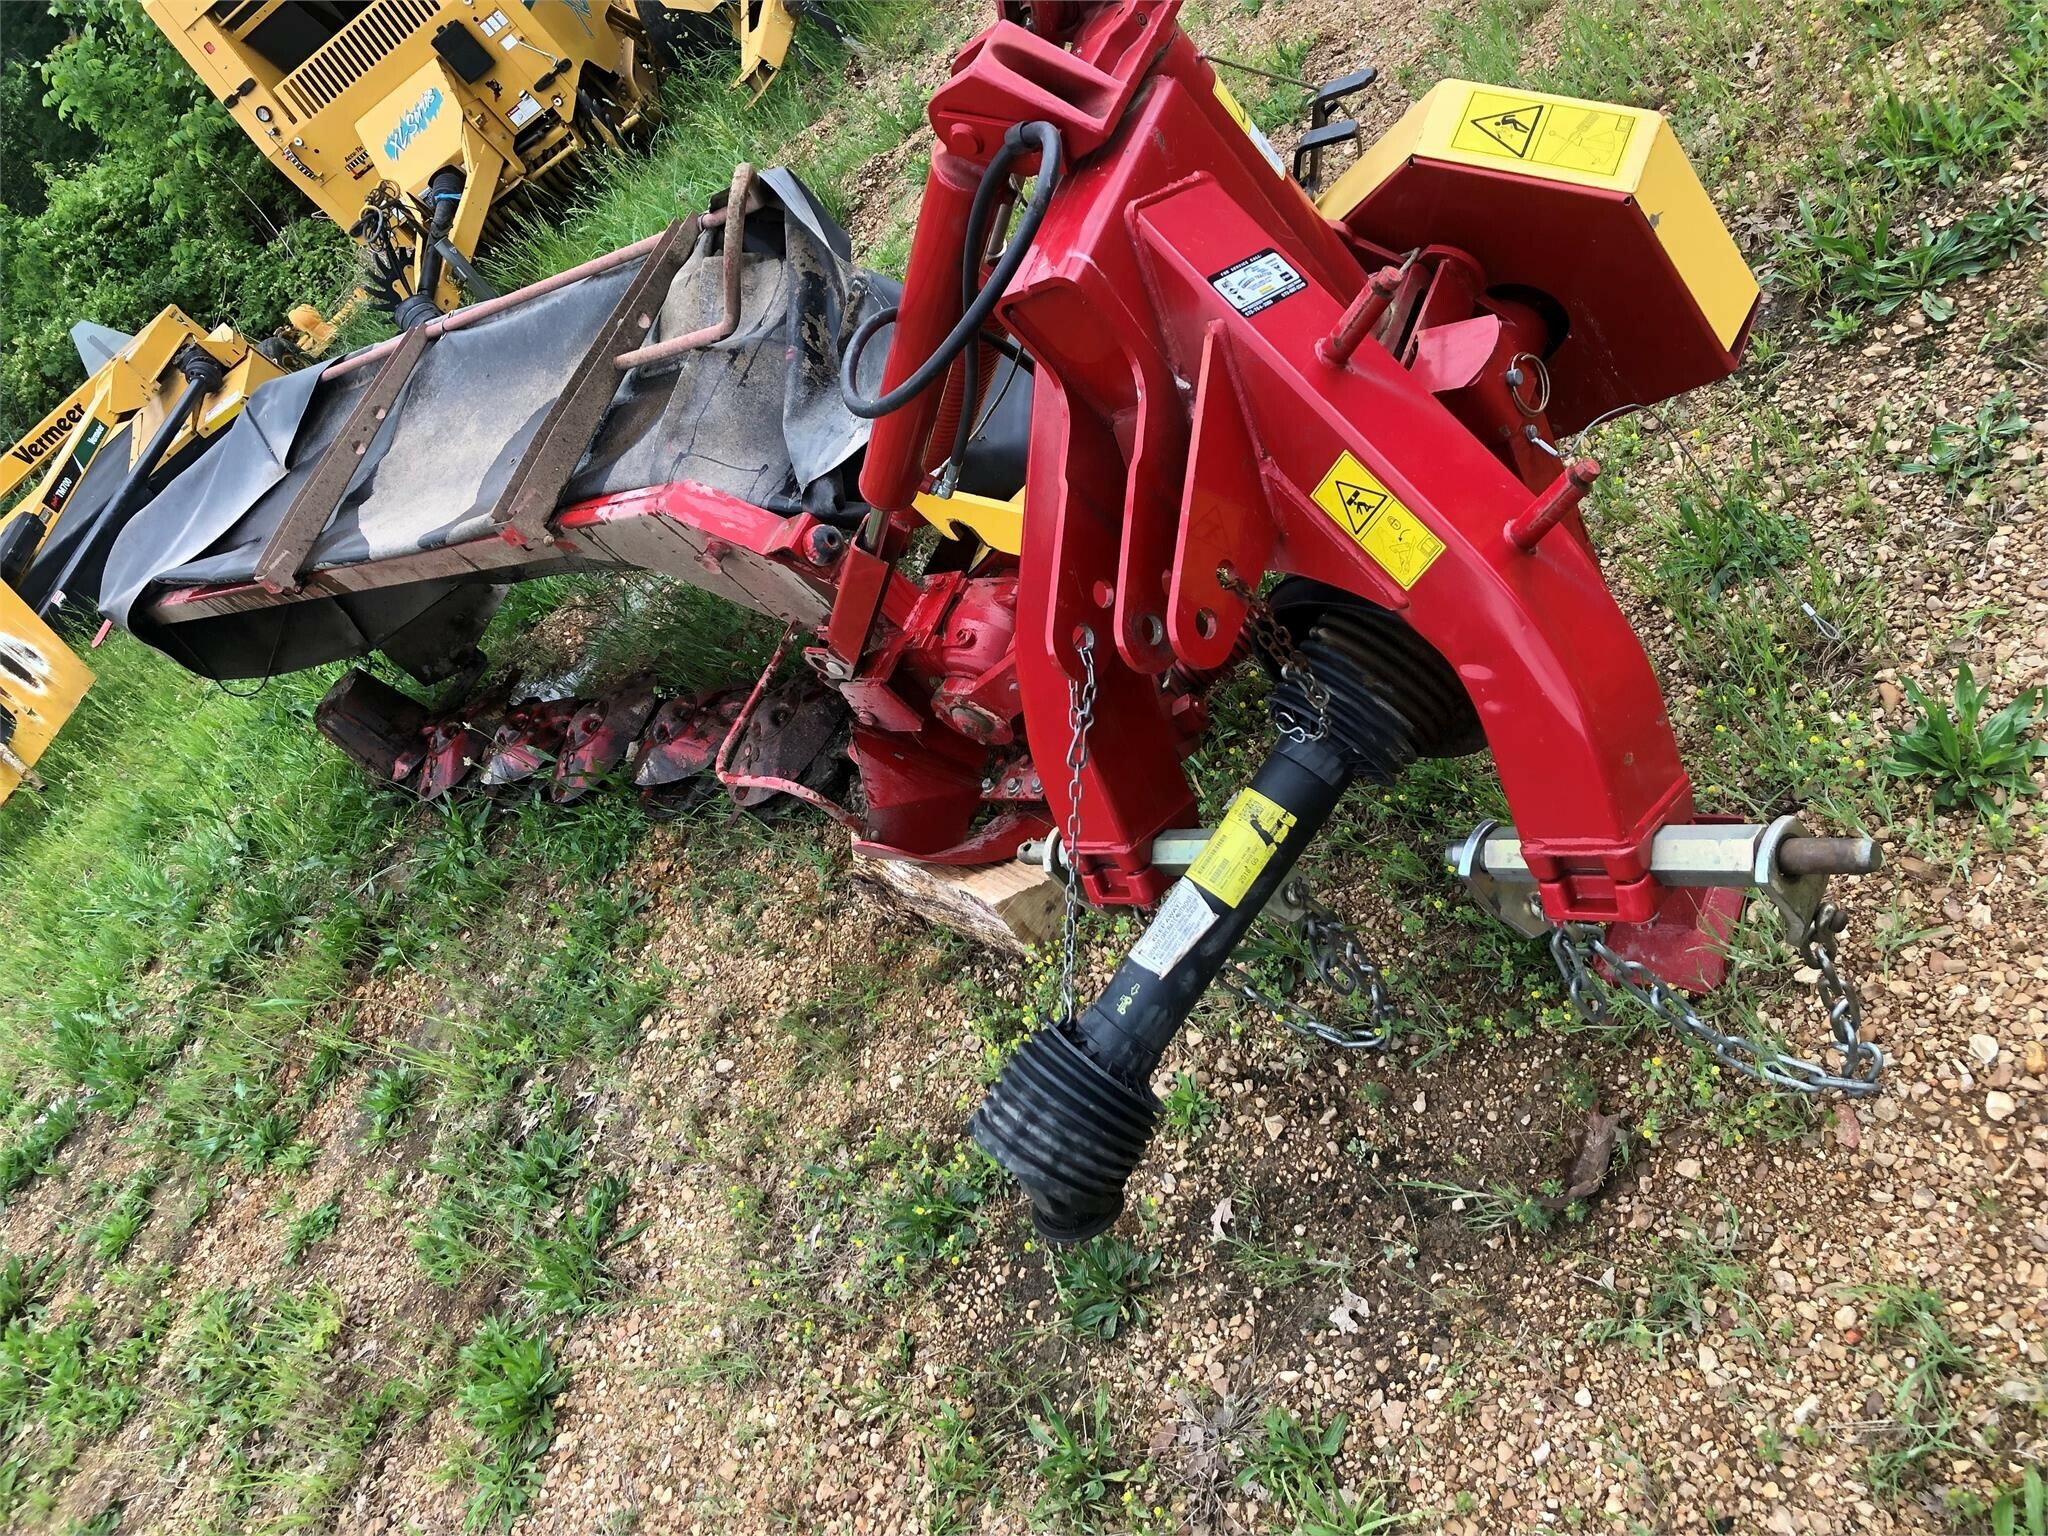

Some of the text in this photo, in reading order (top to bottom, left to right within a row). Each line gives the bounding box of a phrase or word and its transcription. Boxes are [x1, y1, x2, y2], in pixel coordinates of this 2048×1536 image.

[12, 402, 86, 465] Vermeer
[86, 421, 105, 445] Vermeer
[55, 477, 73, 498] TM700
